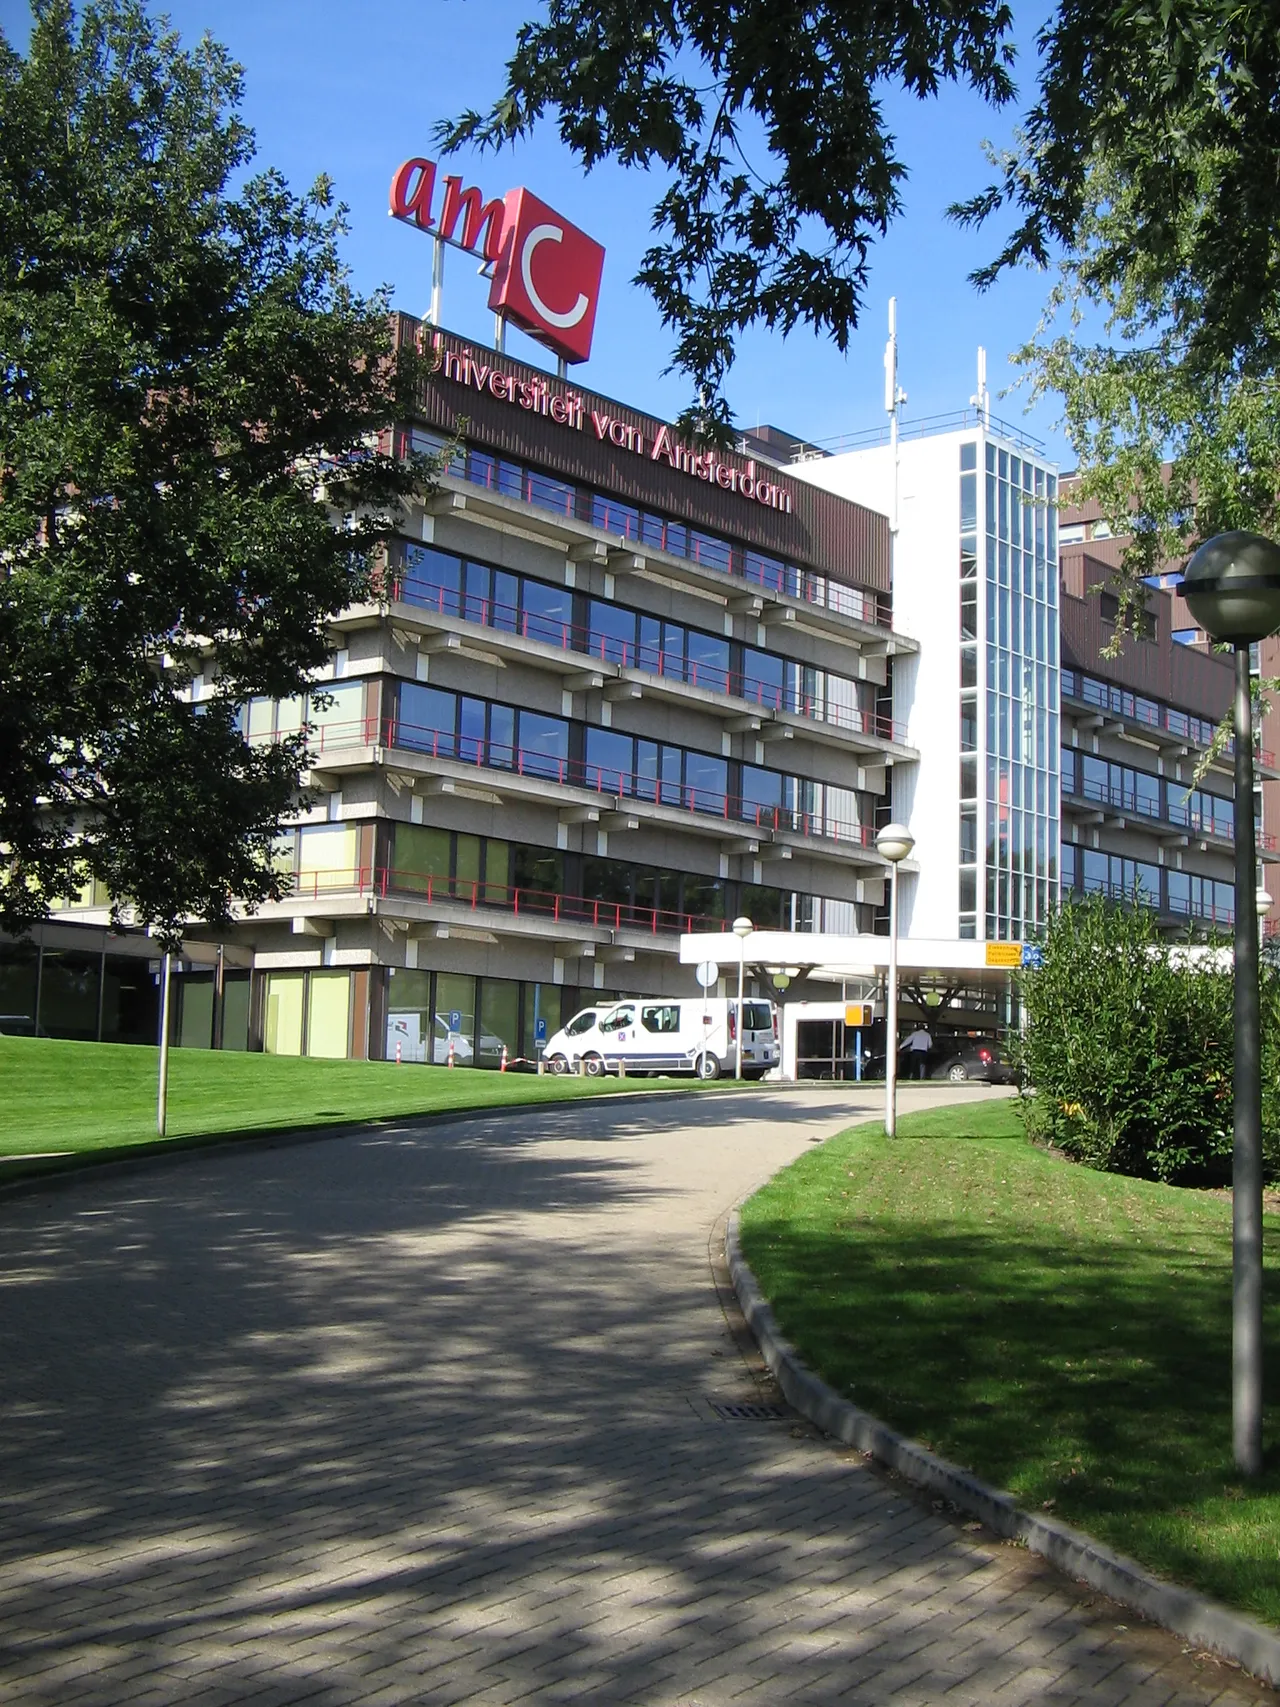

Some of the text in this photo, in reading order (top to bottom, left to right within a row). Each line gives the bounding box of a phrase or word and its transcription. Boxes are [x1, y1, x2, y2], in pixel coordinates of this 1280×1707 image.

[416, 325, 792, 514] Universiteit van Amsterdam
